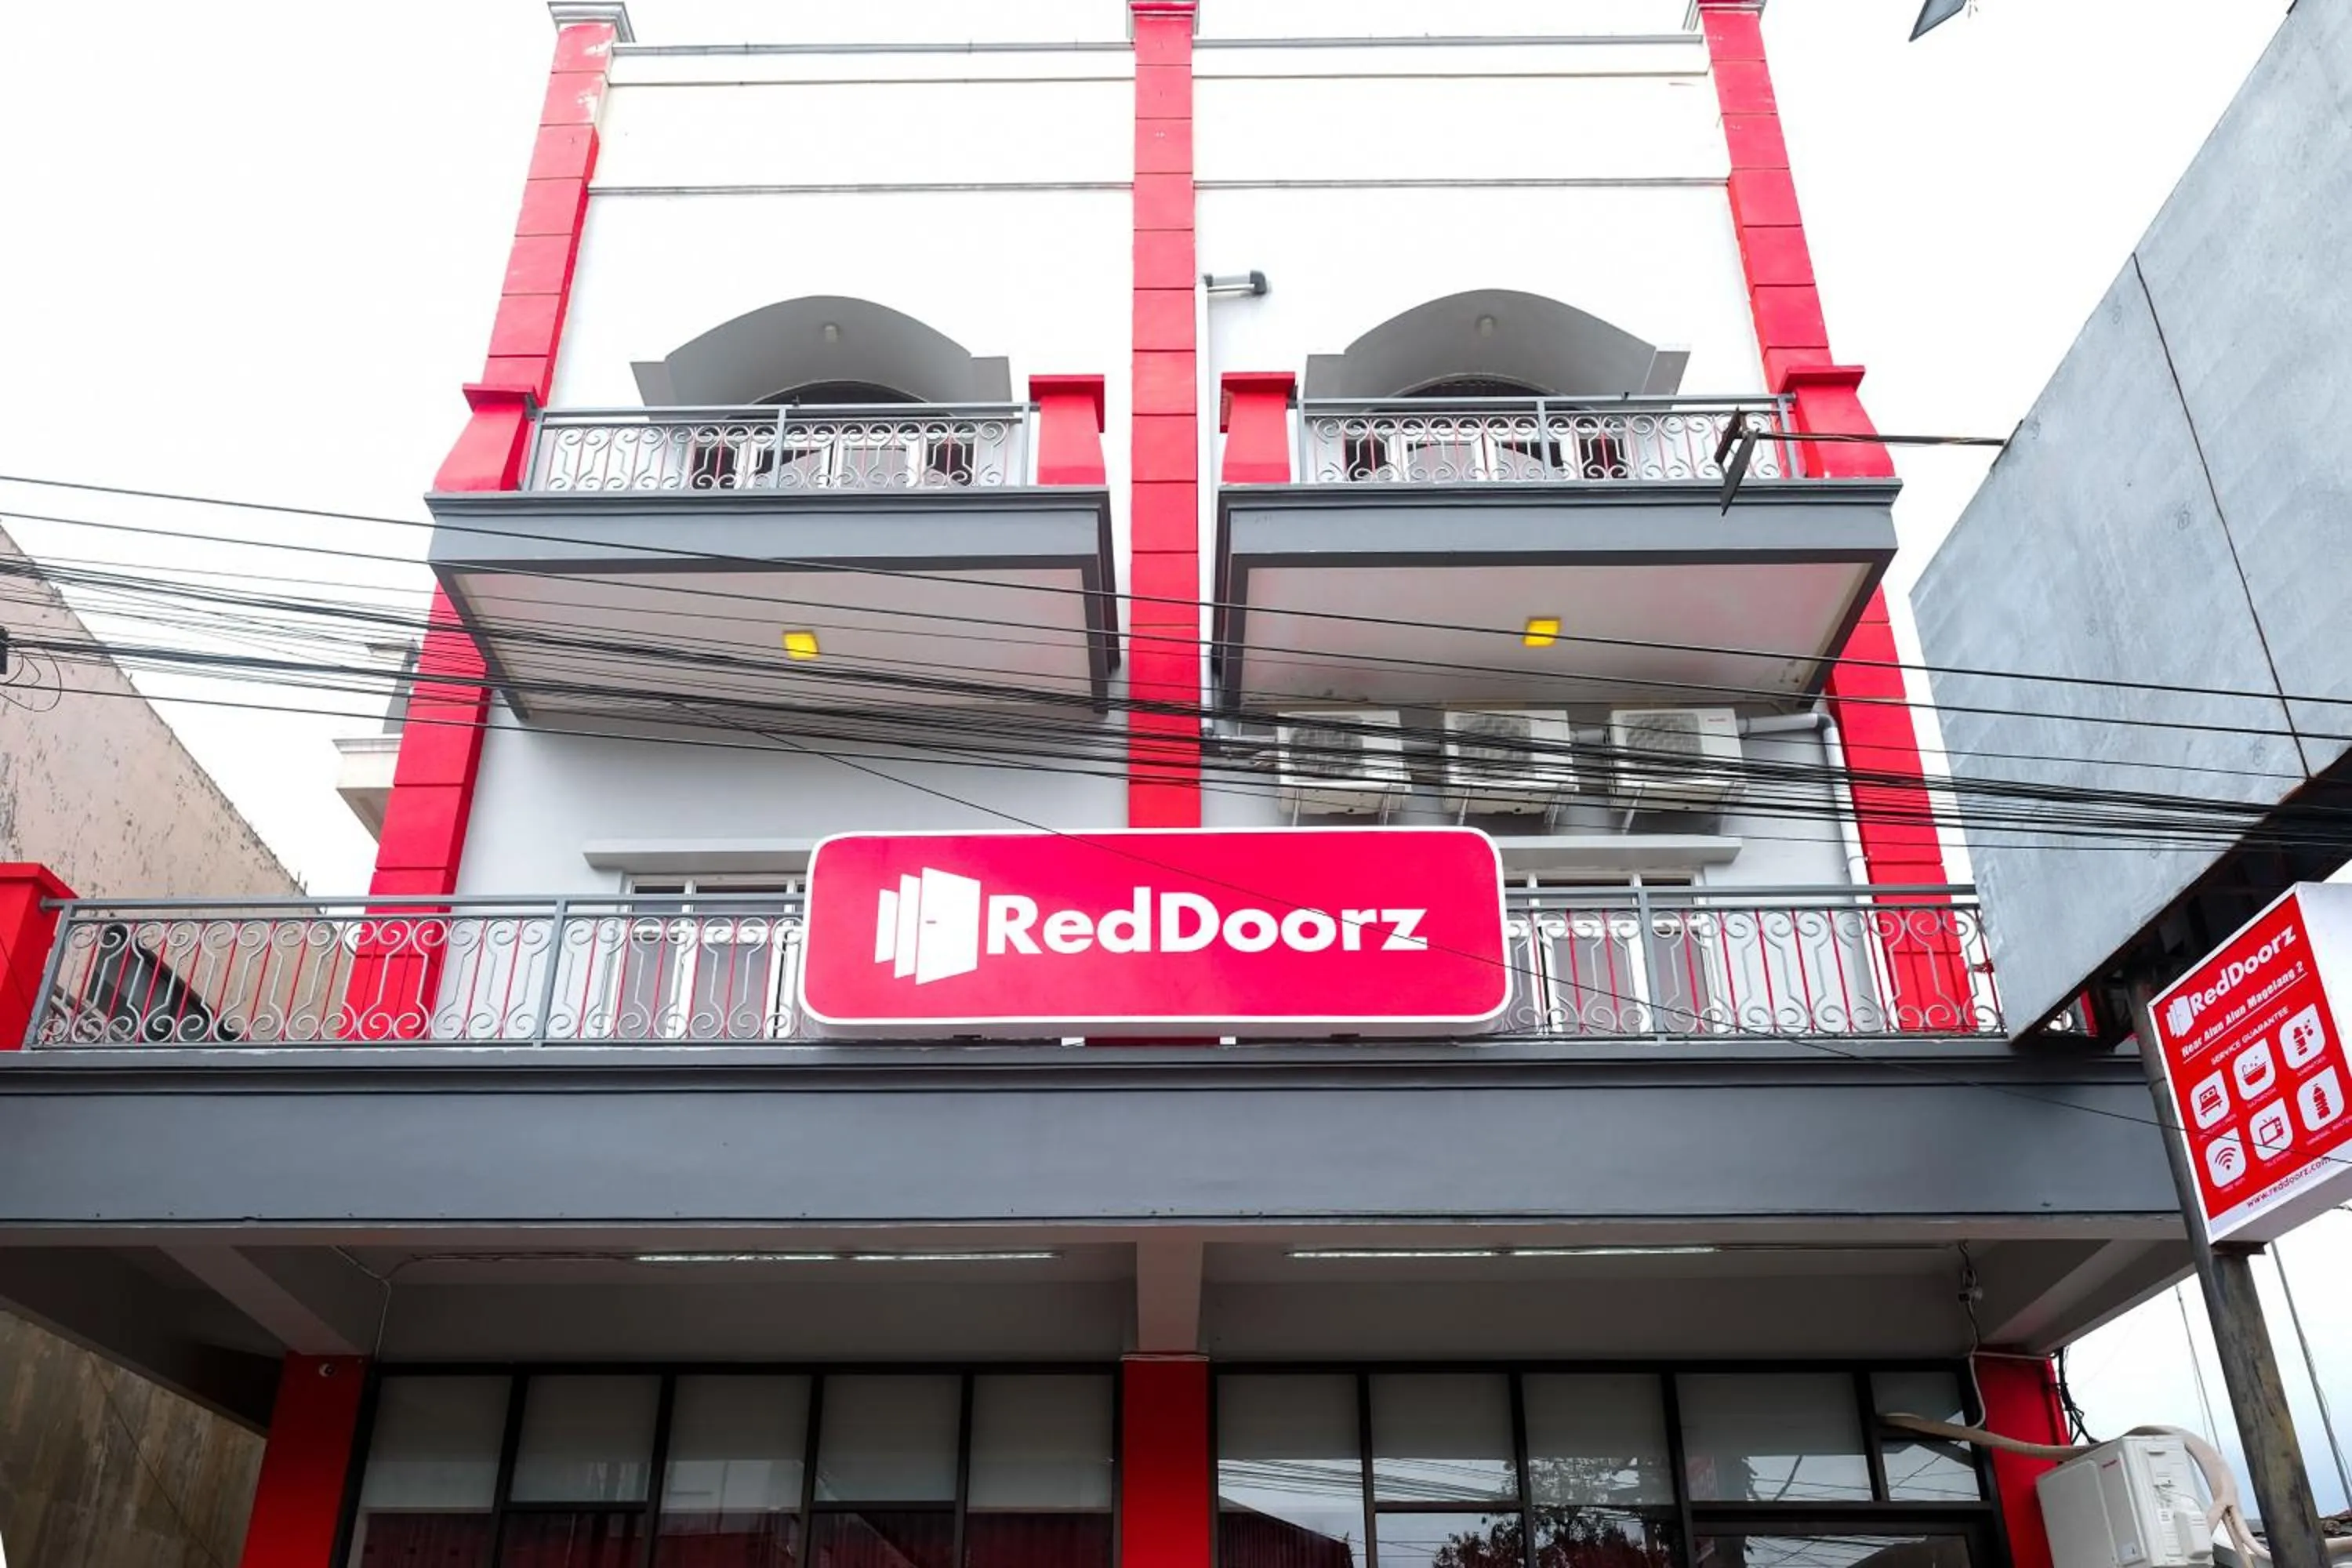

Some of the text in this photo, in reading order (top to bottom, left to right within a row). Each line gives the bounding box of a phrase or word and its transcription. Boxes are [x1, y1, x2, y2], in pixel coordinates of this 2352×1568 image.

[985, 886, 1428, 955] RedDoorz
[2189, 925, 2296, 1016] RedDoorz
[2296, 960, 2304, 973] 2
[2241, 1006, 2289, 1044] GUARANTEE
[2247, 1157, 2331, 1208] www.reddoorz.com
